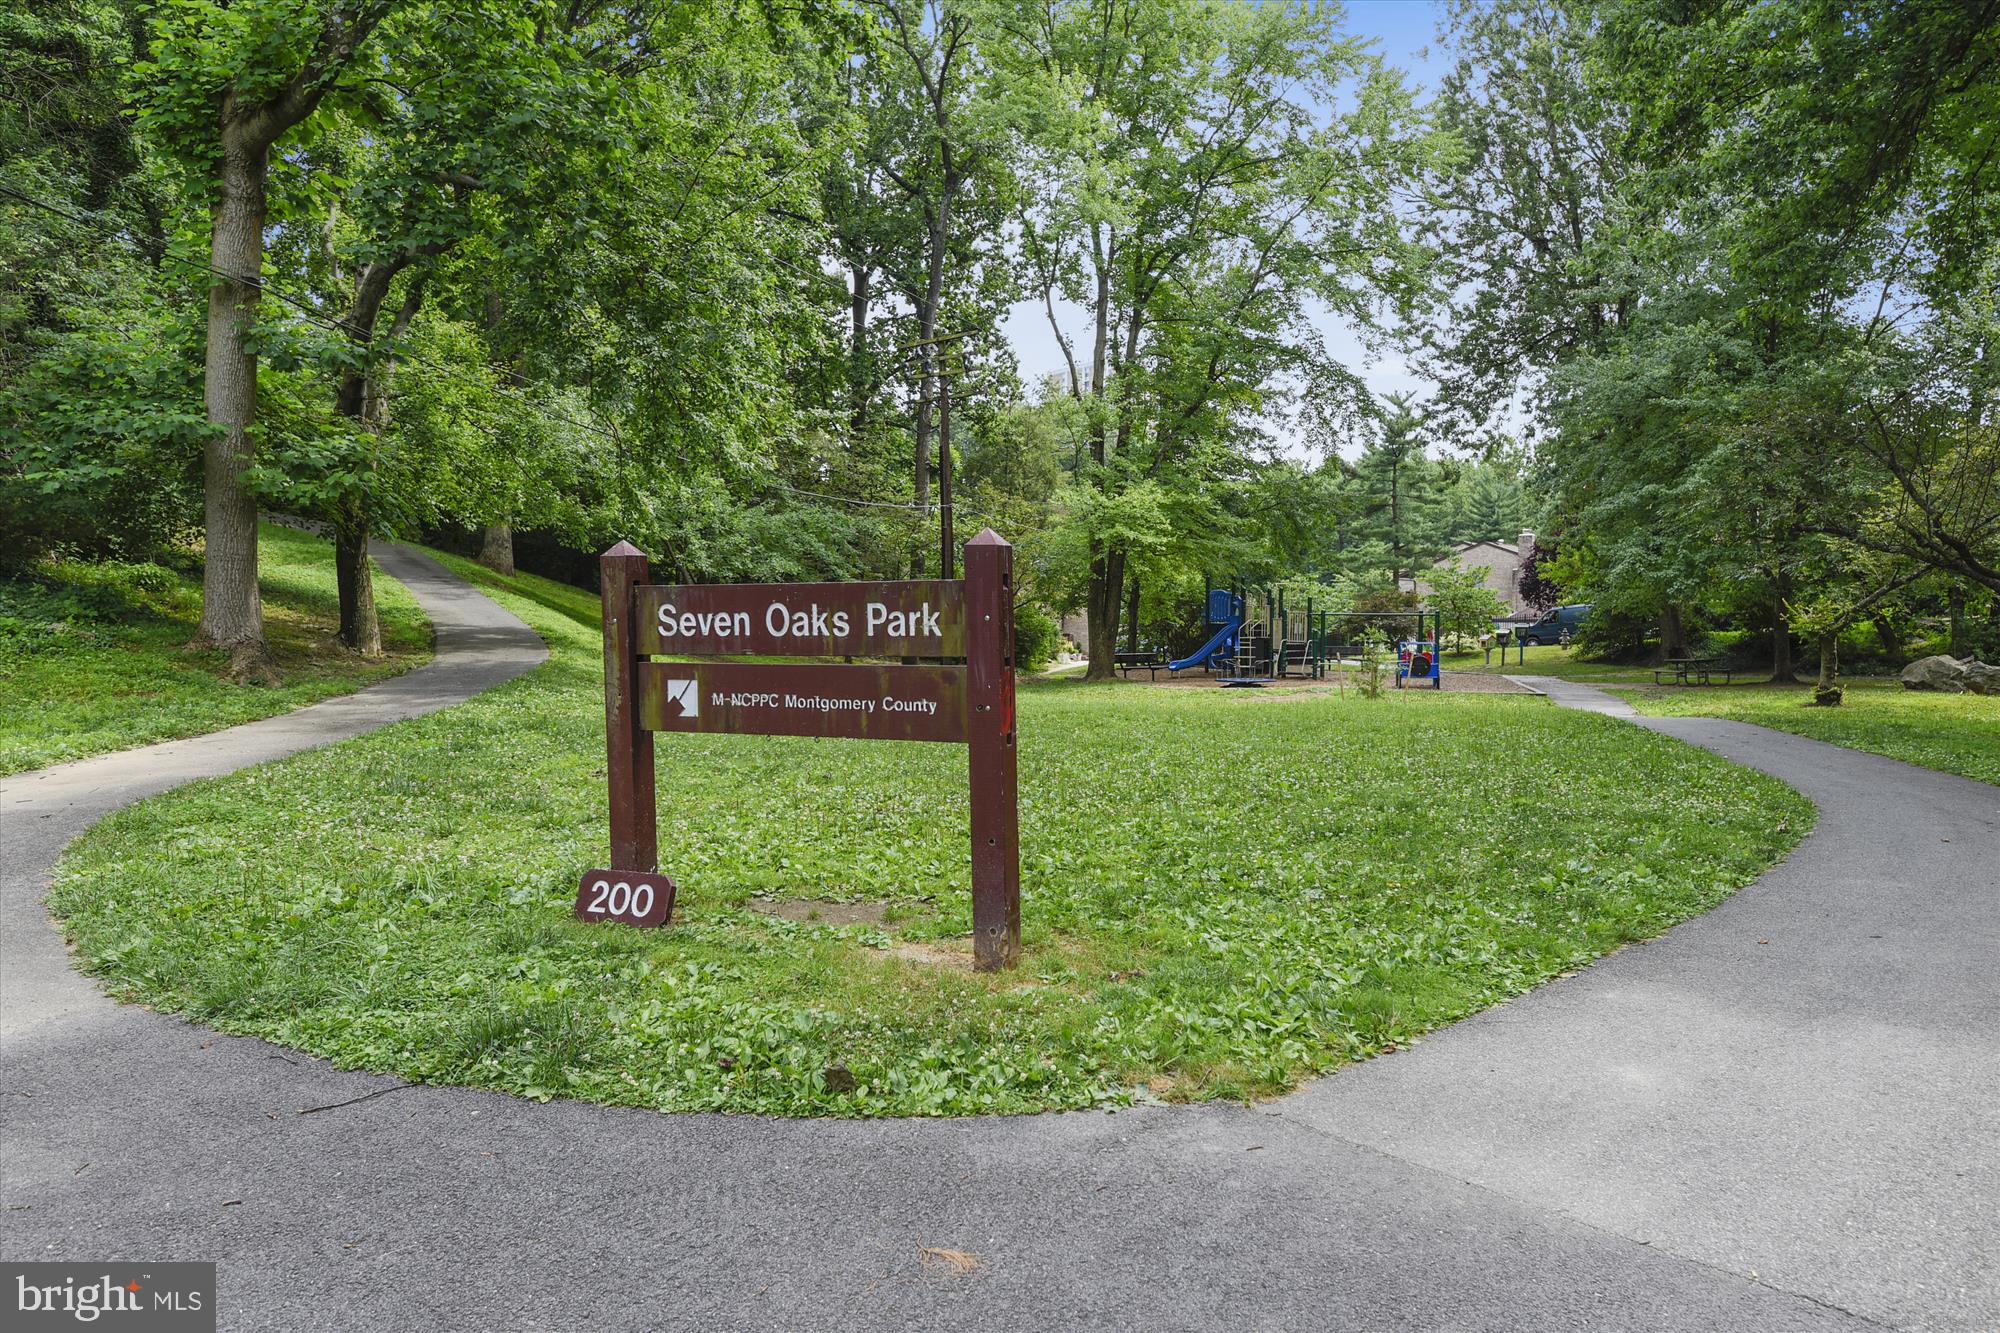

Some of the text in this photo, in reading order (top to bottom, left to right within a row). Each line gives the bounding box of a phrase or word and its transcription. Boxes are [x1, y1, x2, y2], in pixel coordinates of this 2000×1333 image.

[657, 602, 943, 638] Seven Oaks Park
[711, 692, 937, 715] M-NCPPC Montgomery County
[587, 880, 655, 918] 200
